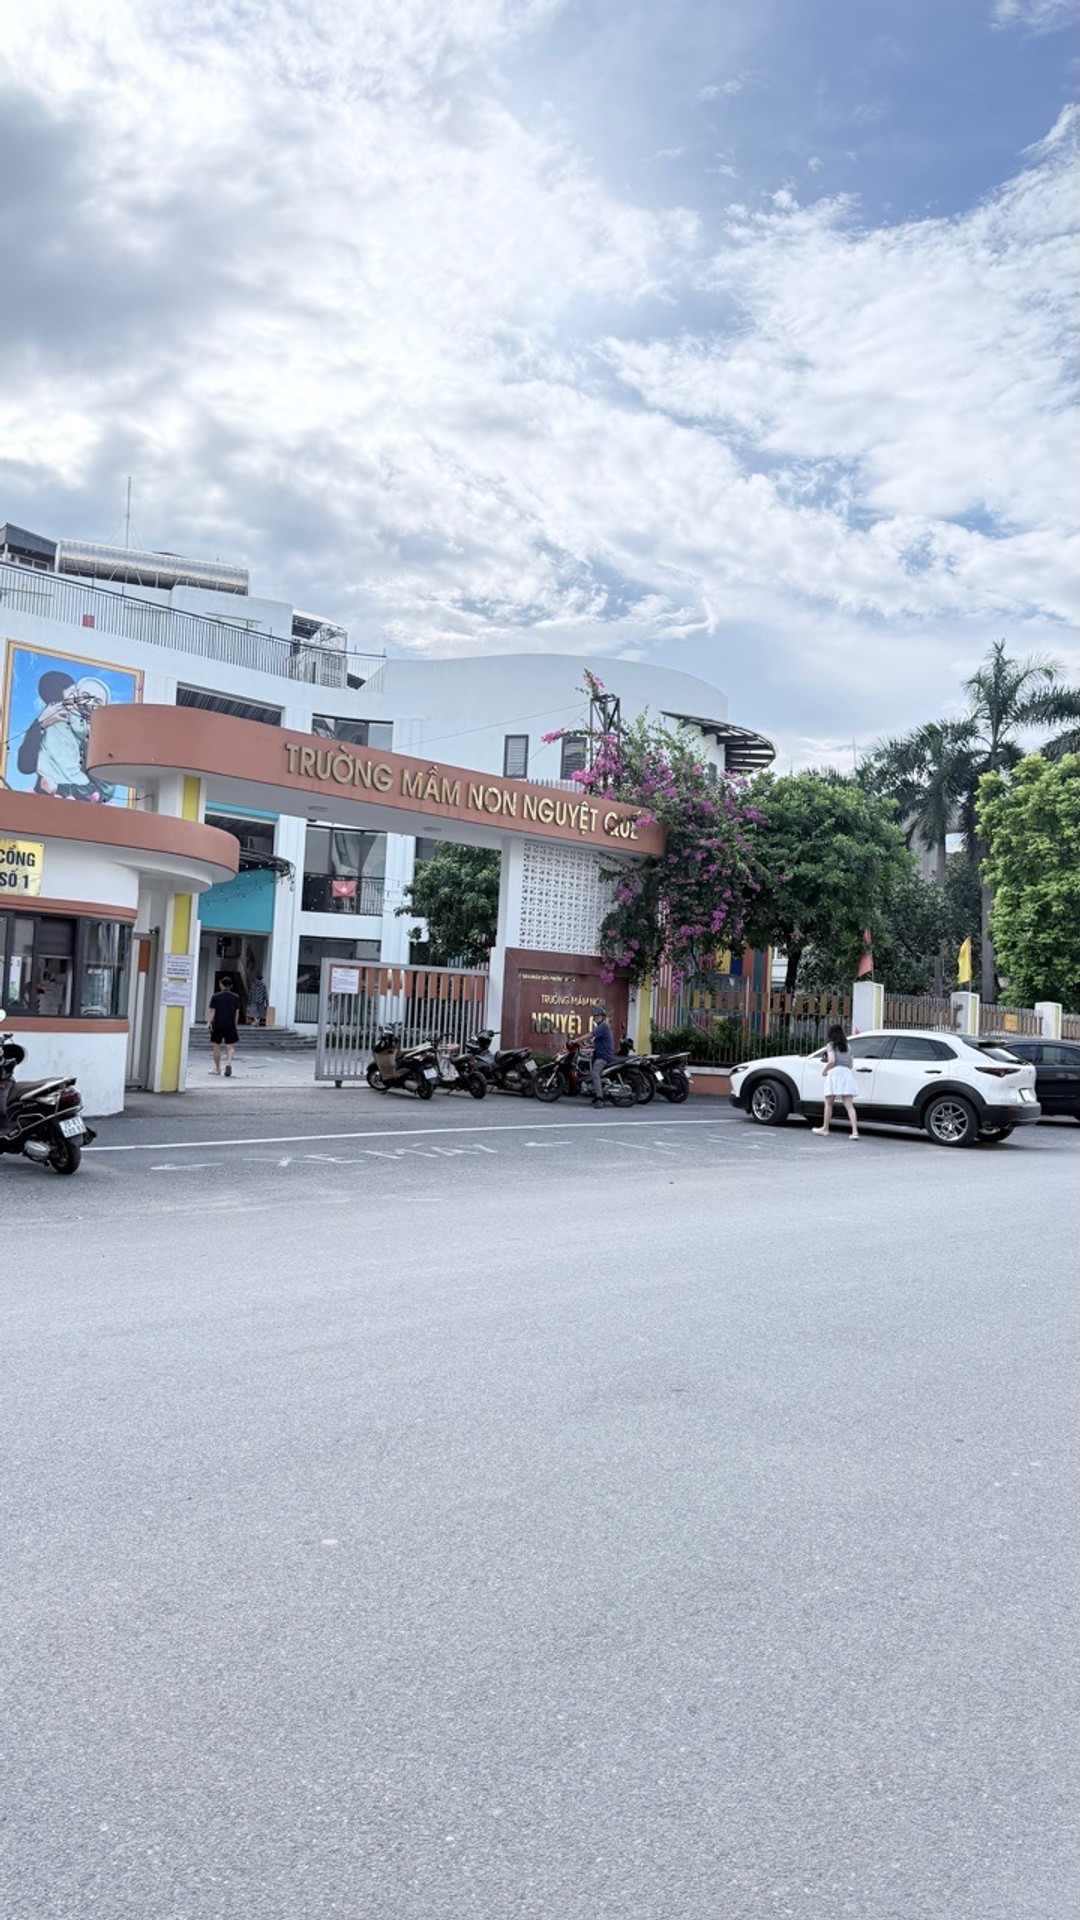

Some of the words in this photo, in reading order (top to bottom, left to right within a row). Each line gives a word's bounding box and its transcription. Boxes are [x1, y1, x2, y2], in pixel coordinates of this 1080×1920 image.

[285, 743, 394, 792] TRƯỜNG
[401, 765, 461, 806] MẦM
[467, 782, 517, 816] NON
[523, 795, 598, 835] NGUYỆT
[22, 874, 29, 889] 1
[531, 1010, 582, 1038] NGUYỆT
